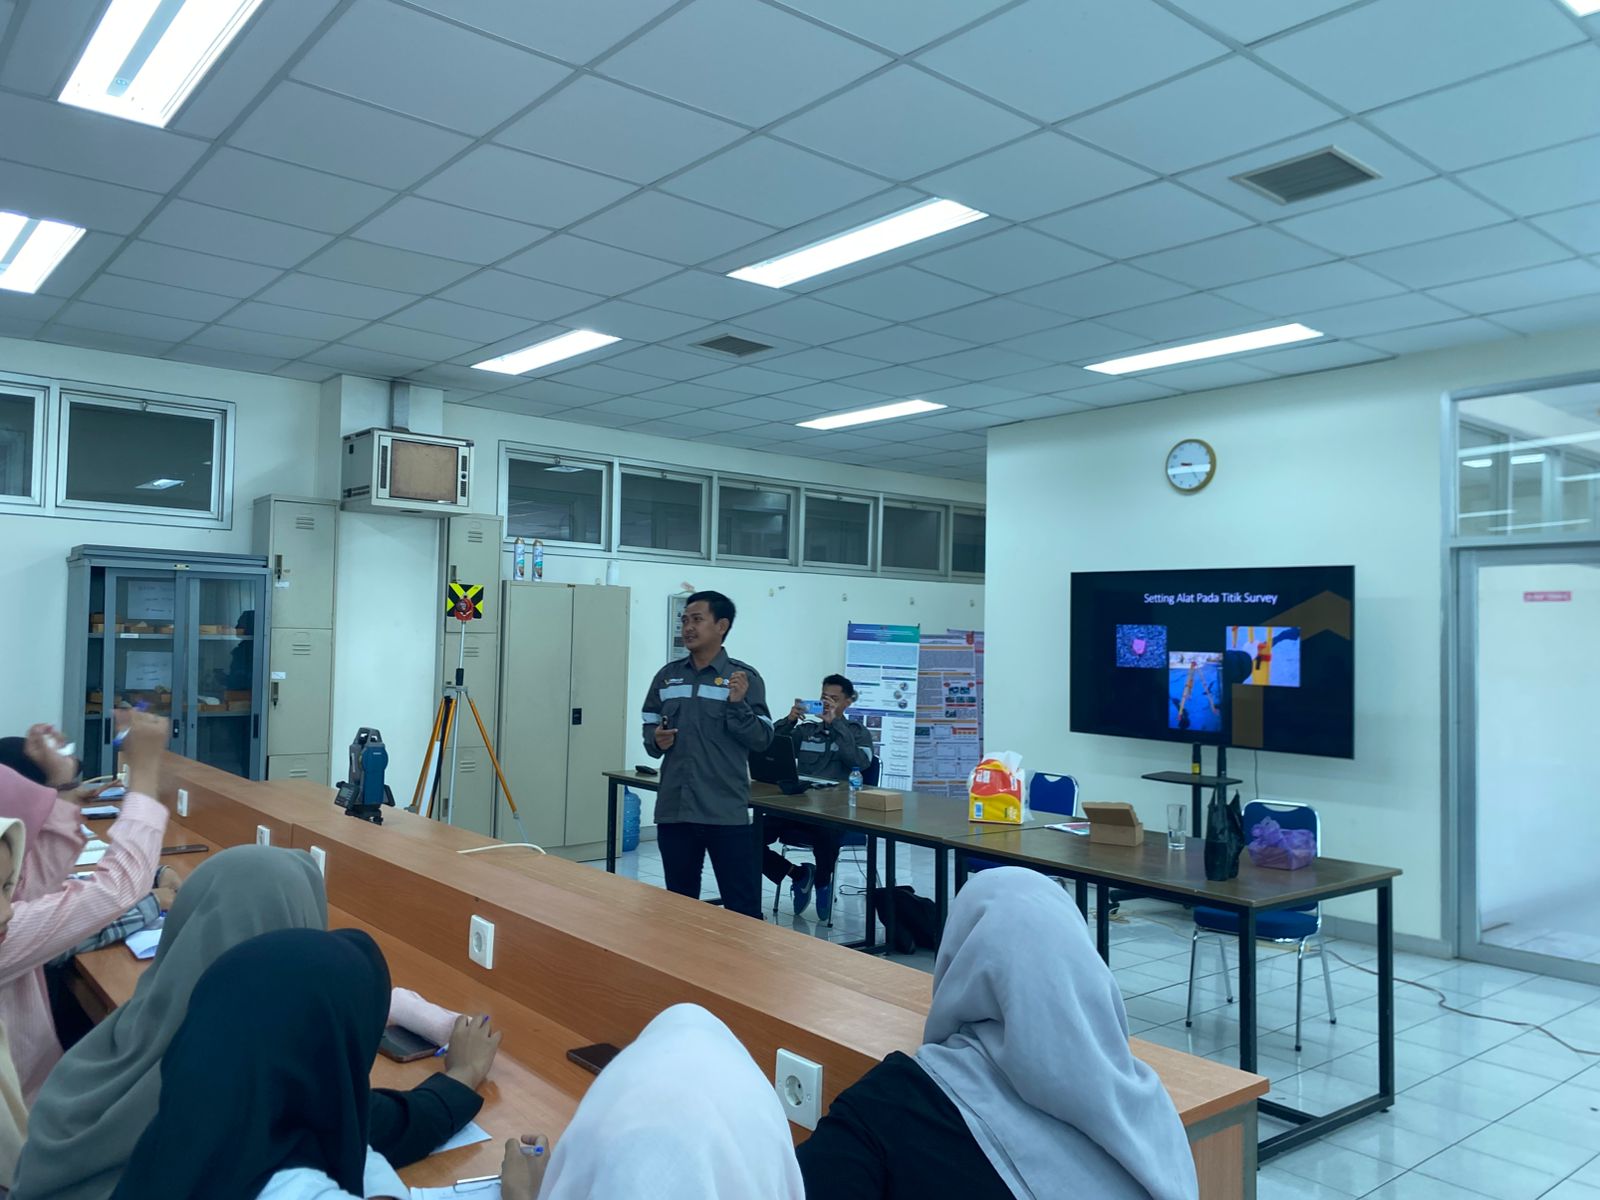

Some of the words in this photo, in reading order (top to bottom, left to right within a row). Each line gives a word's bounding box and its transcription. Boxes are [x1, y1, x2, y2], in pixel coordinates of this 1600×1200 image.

[1143, 593, 1175, 605] Setting
[1176, 592, 1195, 603] Alat
[1196, 592, 1219, 603] Pada
[1221, 592, 1242, 603] Titik
[1243, 592, 1278, 605] Survey
